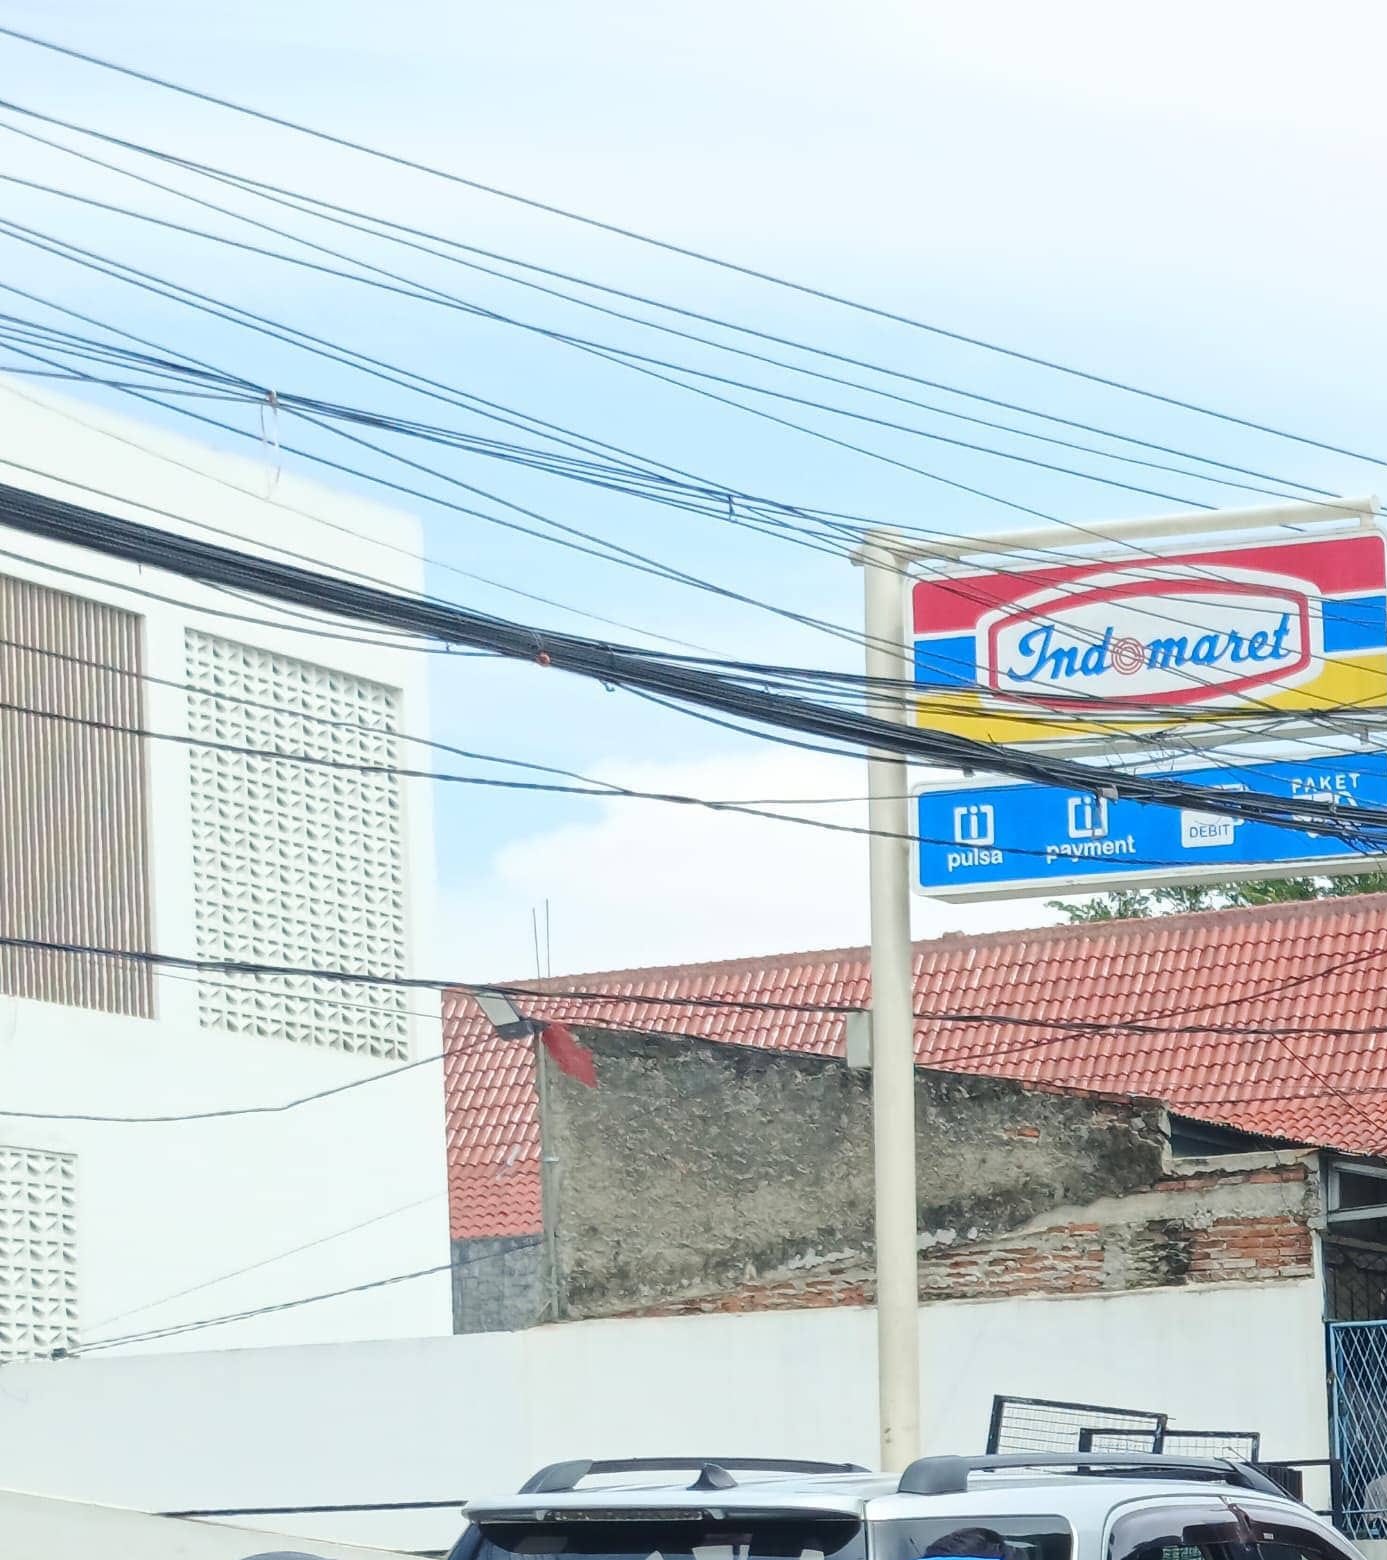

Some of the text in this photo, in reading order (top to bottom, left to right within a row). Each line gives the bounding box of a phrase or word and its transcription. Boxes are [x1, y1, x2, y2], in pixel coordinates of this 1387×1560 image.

[1007, 613, 1291, 683] Indomaret
[947, 823, 1230, 872] pulsa payment DEBIT
